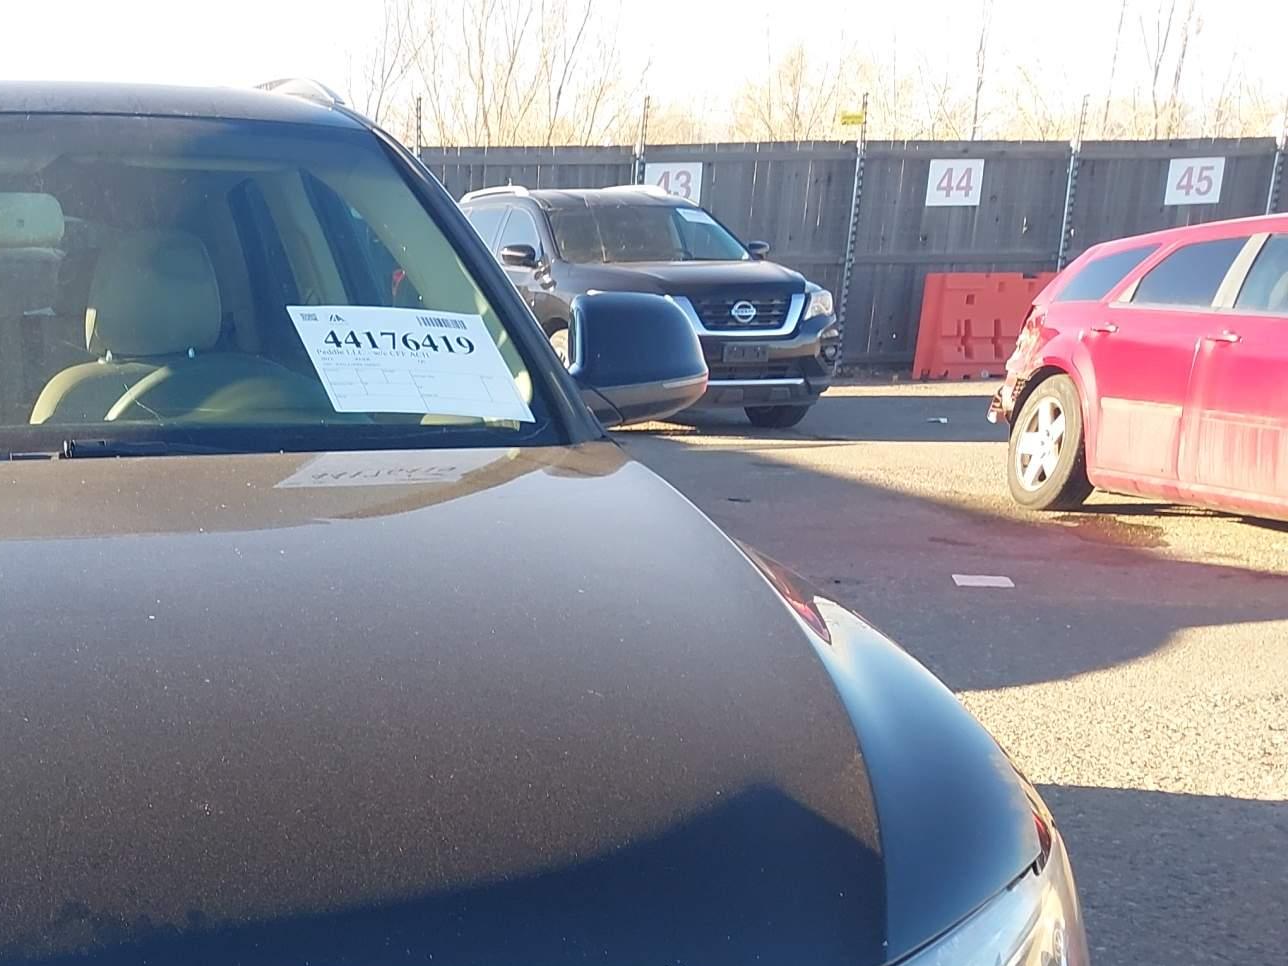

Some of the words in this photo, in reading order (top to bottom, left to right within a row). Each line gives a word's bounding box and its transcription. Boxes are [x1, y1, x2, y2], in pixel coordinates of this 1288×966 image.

[936, 167, 973, 198] 44
[1176, 166, 1214, 196] 45
[324, 330, 475, 355] 44176419
